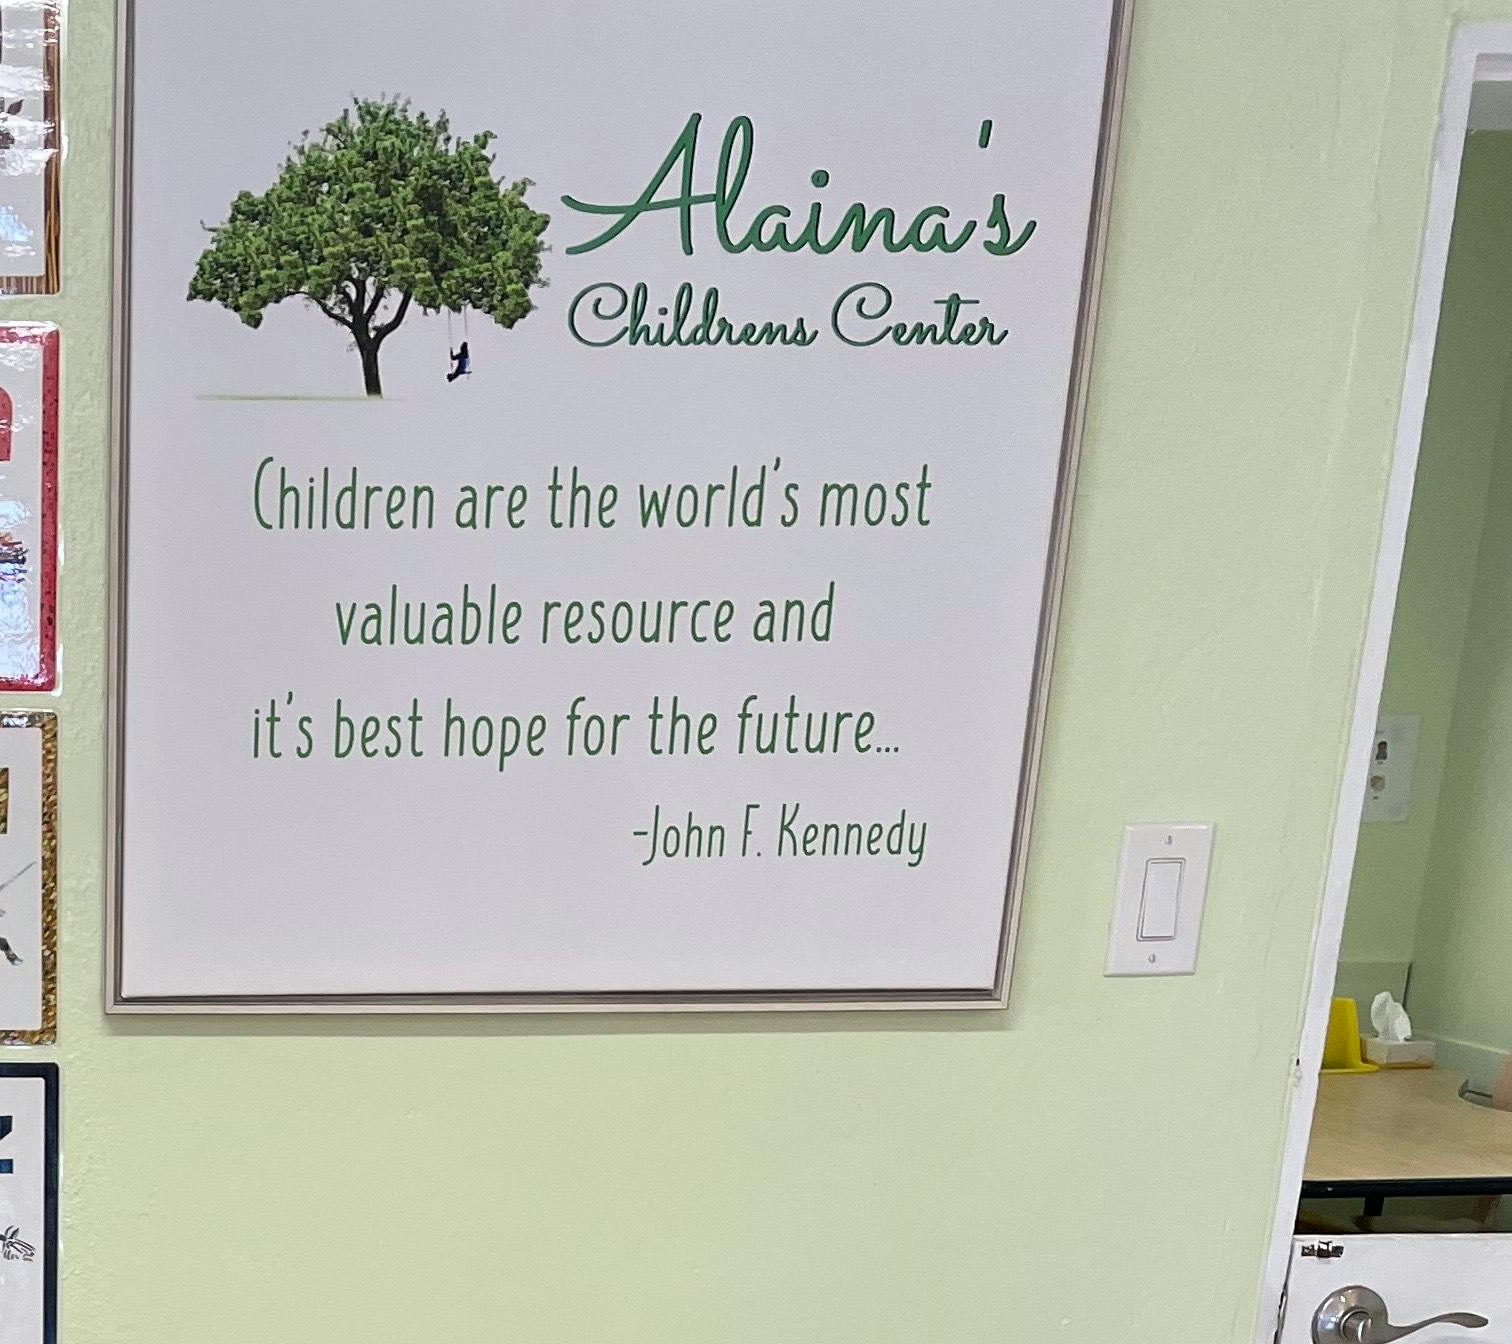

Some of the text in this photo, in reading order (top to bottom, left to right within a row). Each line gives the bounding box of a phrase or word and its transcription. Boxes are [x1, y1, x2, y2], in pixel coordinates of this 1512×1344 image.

[561, 112, 1037, 256] Alaina's
[568, 282, 1008, 347] Childrens Center
[254, 457, 932, 530] Children are the world's most
[336, 581, 835, 646] valuable resource and
[254, 691, 312, 758] it's
[335, 698, 423, 758] best
[444, 698, 546, 772] hope
[566, 696, 630, 756] for
[648, 696, 717, 755] the
[742, 804, 760, 857] F.
[778, 803, 927, 867] Kennedy
